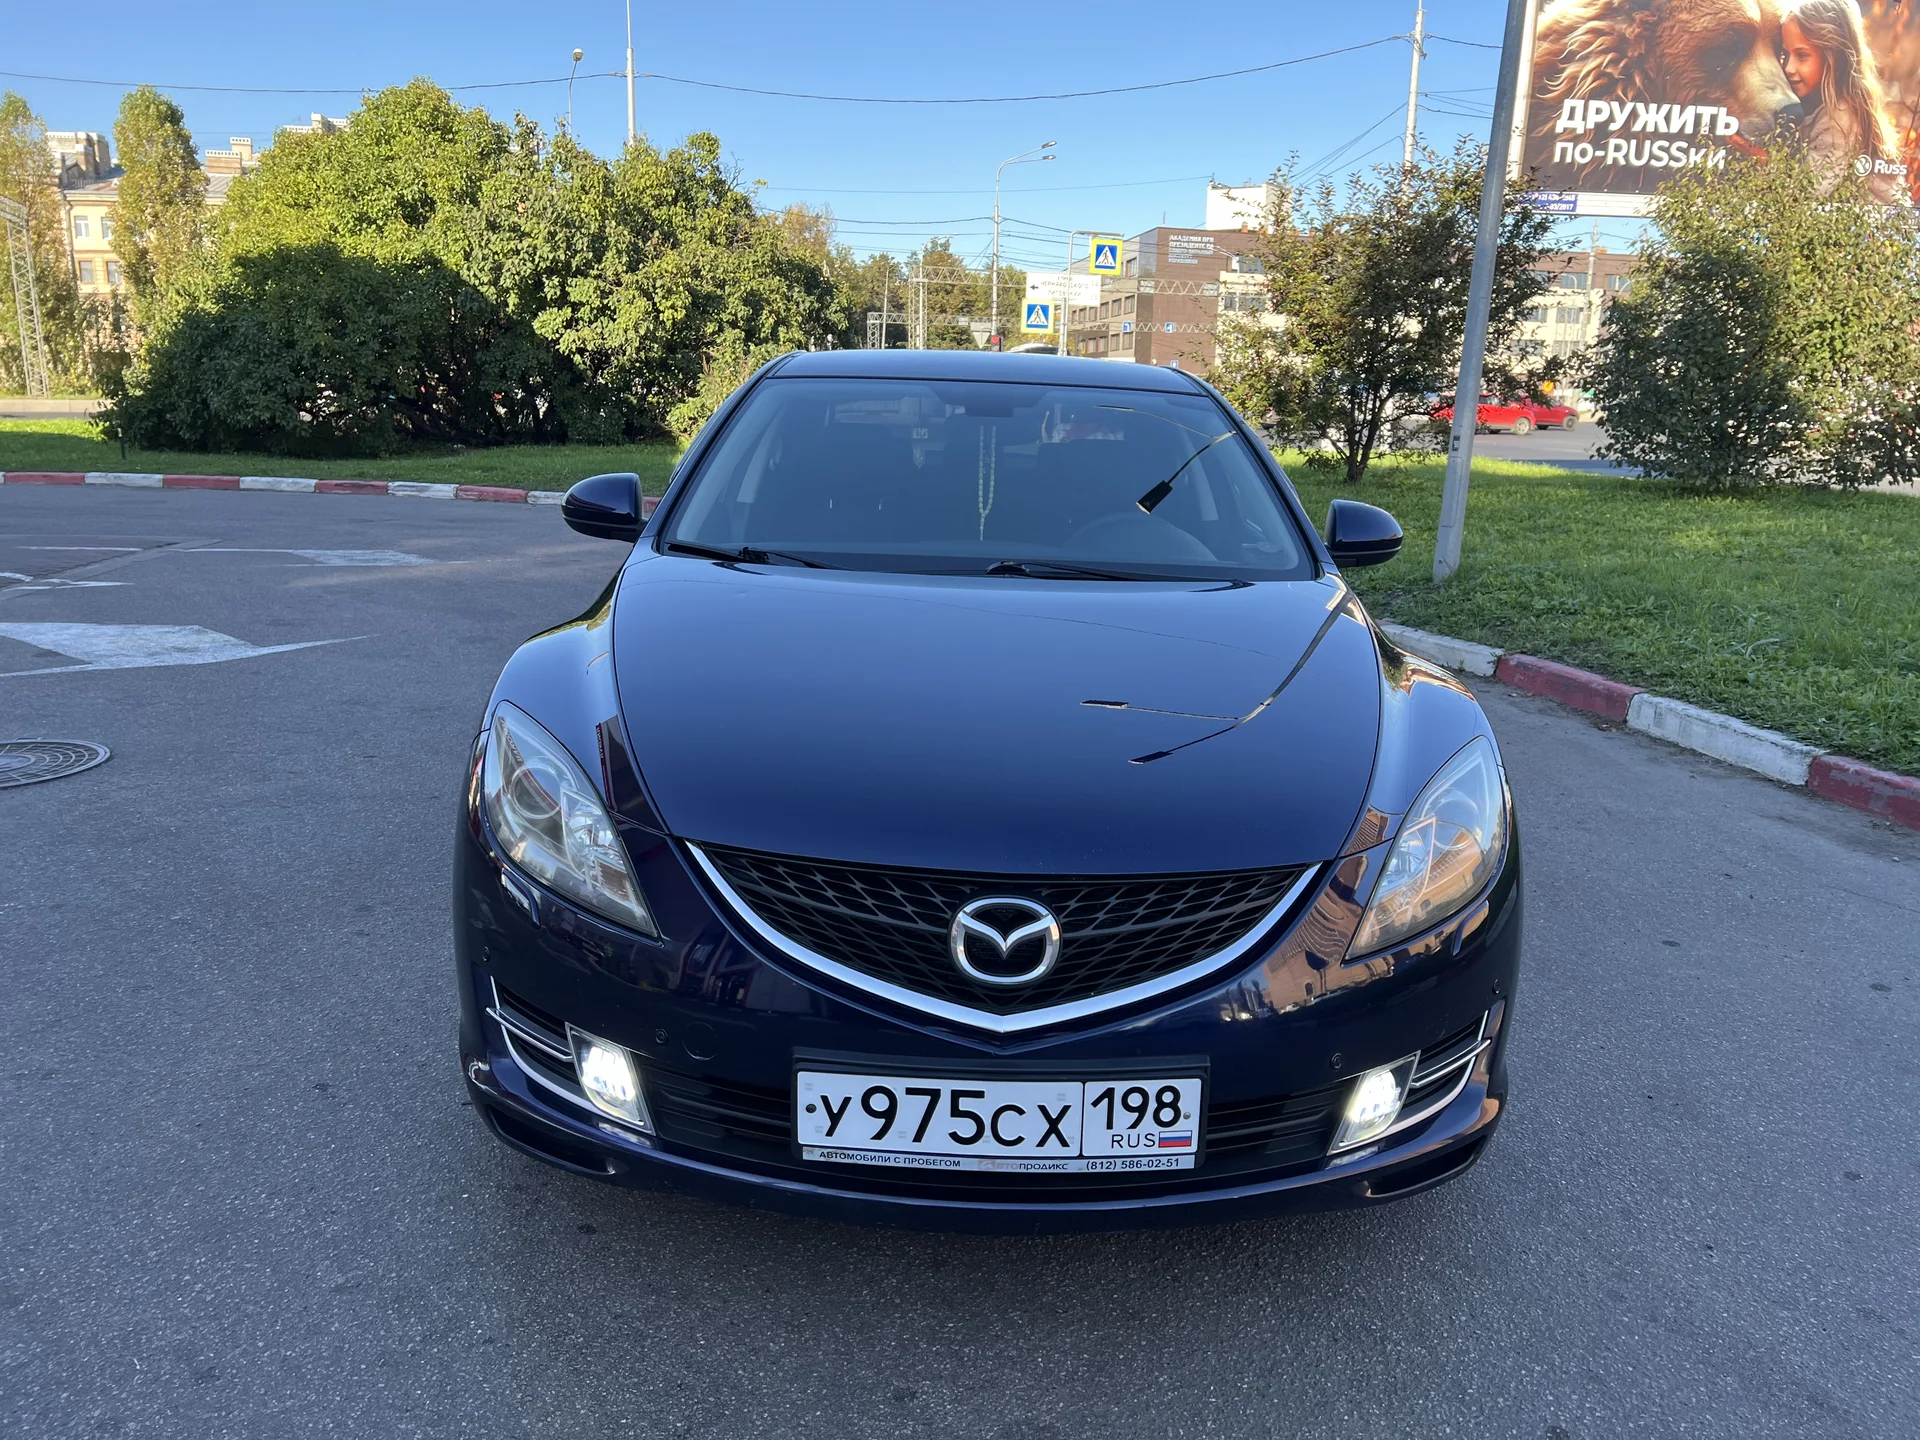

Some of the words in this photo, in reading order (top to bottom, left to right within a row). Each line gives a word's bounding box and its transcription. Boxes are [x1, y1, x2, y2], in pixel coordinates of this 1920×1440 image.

[1555, 98, 1740, 136] ДРУЖИТЬ
[1874, 159, 1908, 175] Russ
[1090, 1085, 1182, 1130] 198
[1111, 1132, 1156, 1149] RUS
[819, 1151, 891, 1164] АВТОМОБИЛИ
[903, 1157, 961, 1168] ПРОБЕГОМ
[1086, 1160, 1118, 1171] (812)
[1120, 1158, 1180, 1170] 586-02-51
